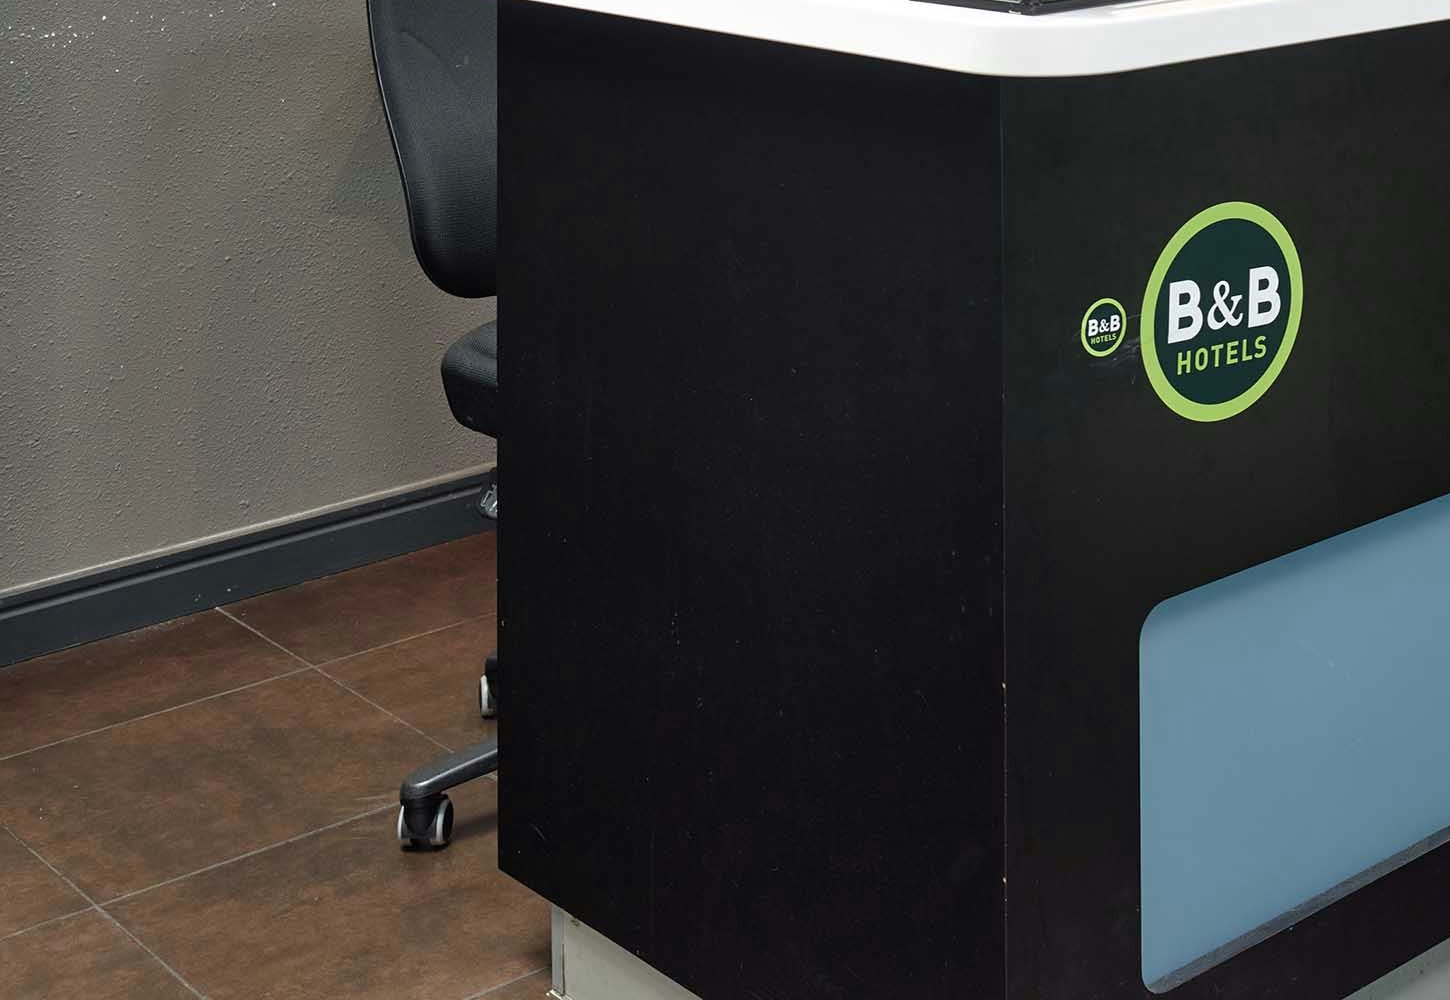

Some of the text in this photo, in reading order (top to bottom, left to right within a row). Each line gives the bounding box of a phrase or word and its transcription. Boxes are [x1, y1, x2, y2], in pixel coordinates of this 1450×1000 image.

[1167, 265, 1281, 344] B&B
[1088, 314, 1121, 337] B&B
[1090, 333, 1117, 345] HOTELS
[1176, 335, 1267, 375] HOTELS
